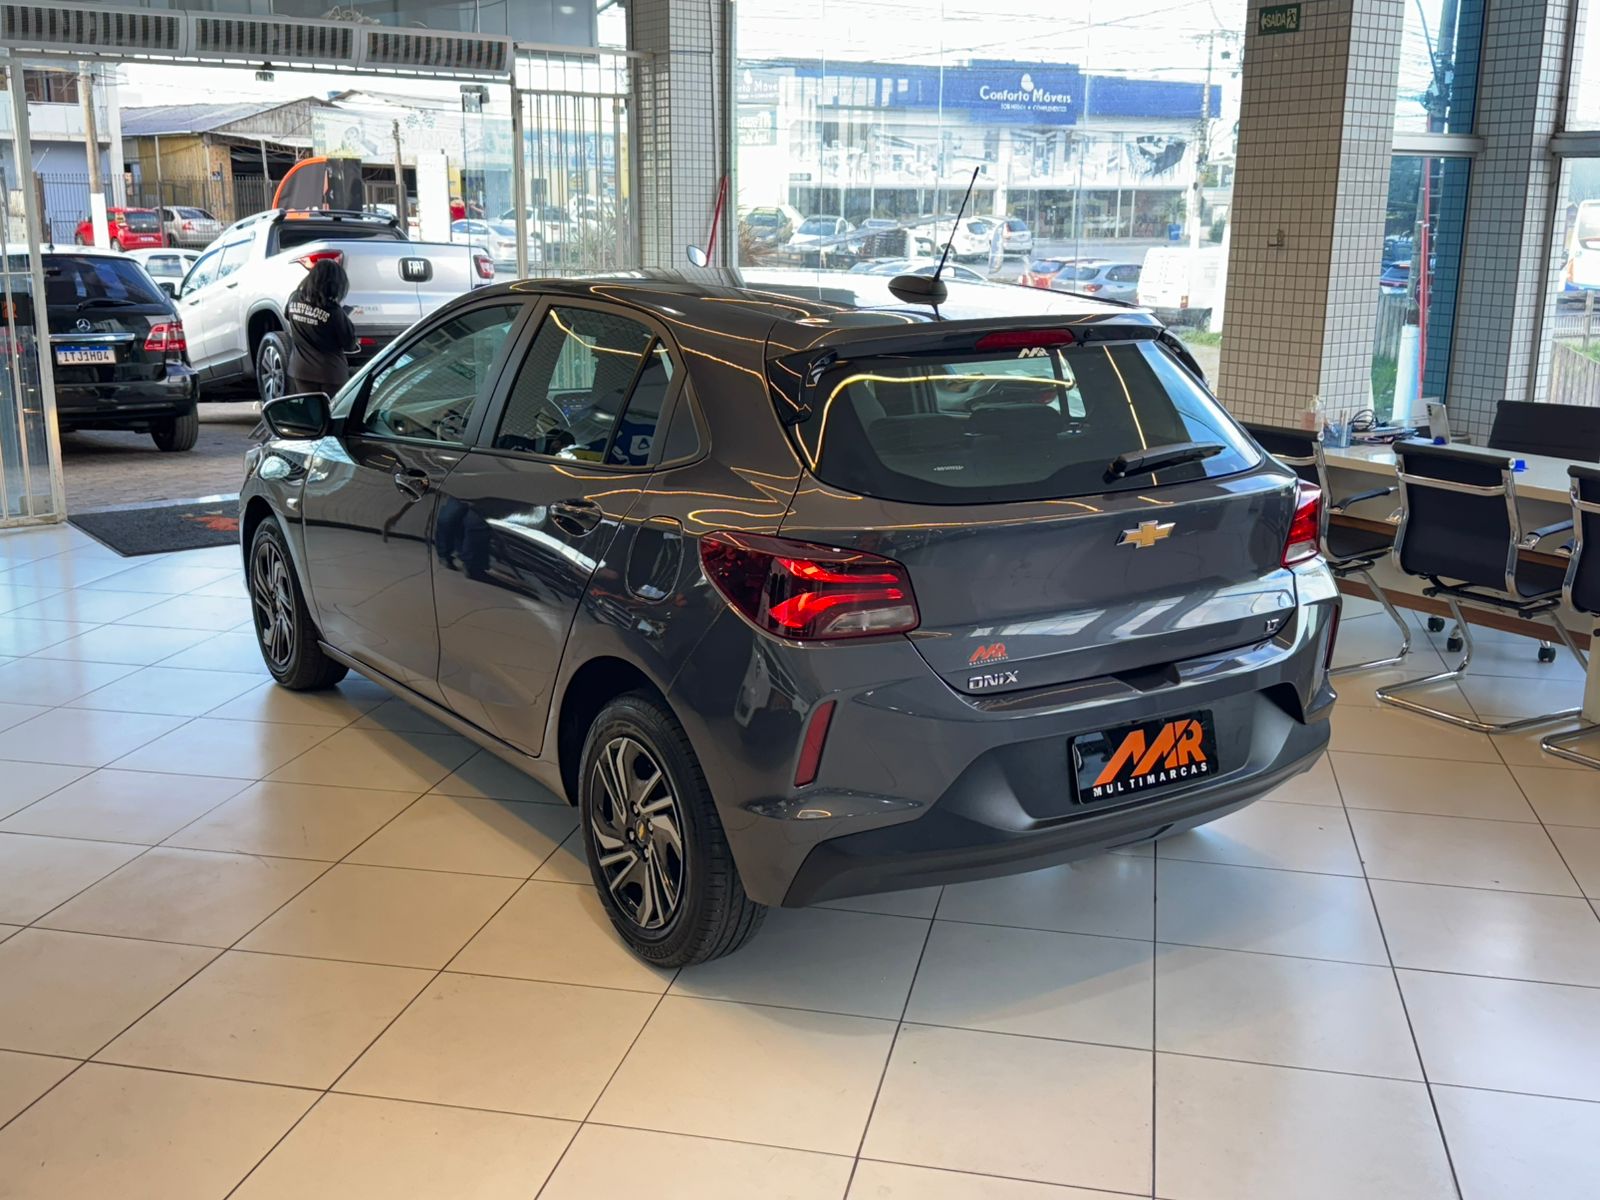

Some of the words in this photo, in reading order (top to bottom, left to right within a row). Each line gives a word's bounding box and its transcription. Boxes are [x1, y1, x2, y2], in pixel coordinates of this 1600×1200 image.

[979, 85, 1030, 102] Conforto
[1032, 88, 1072, 103] Móveis
[407, 260, 425, 275] FIAT
[1092, 762, 1208, 797] MULTIMARCAS
